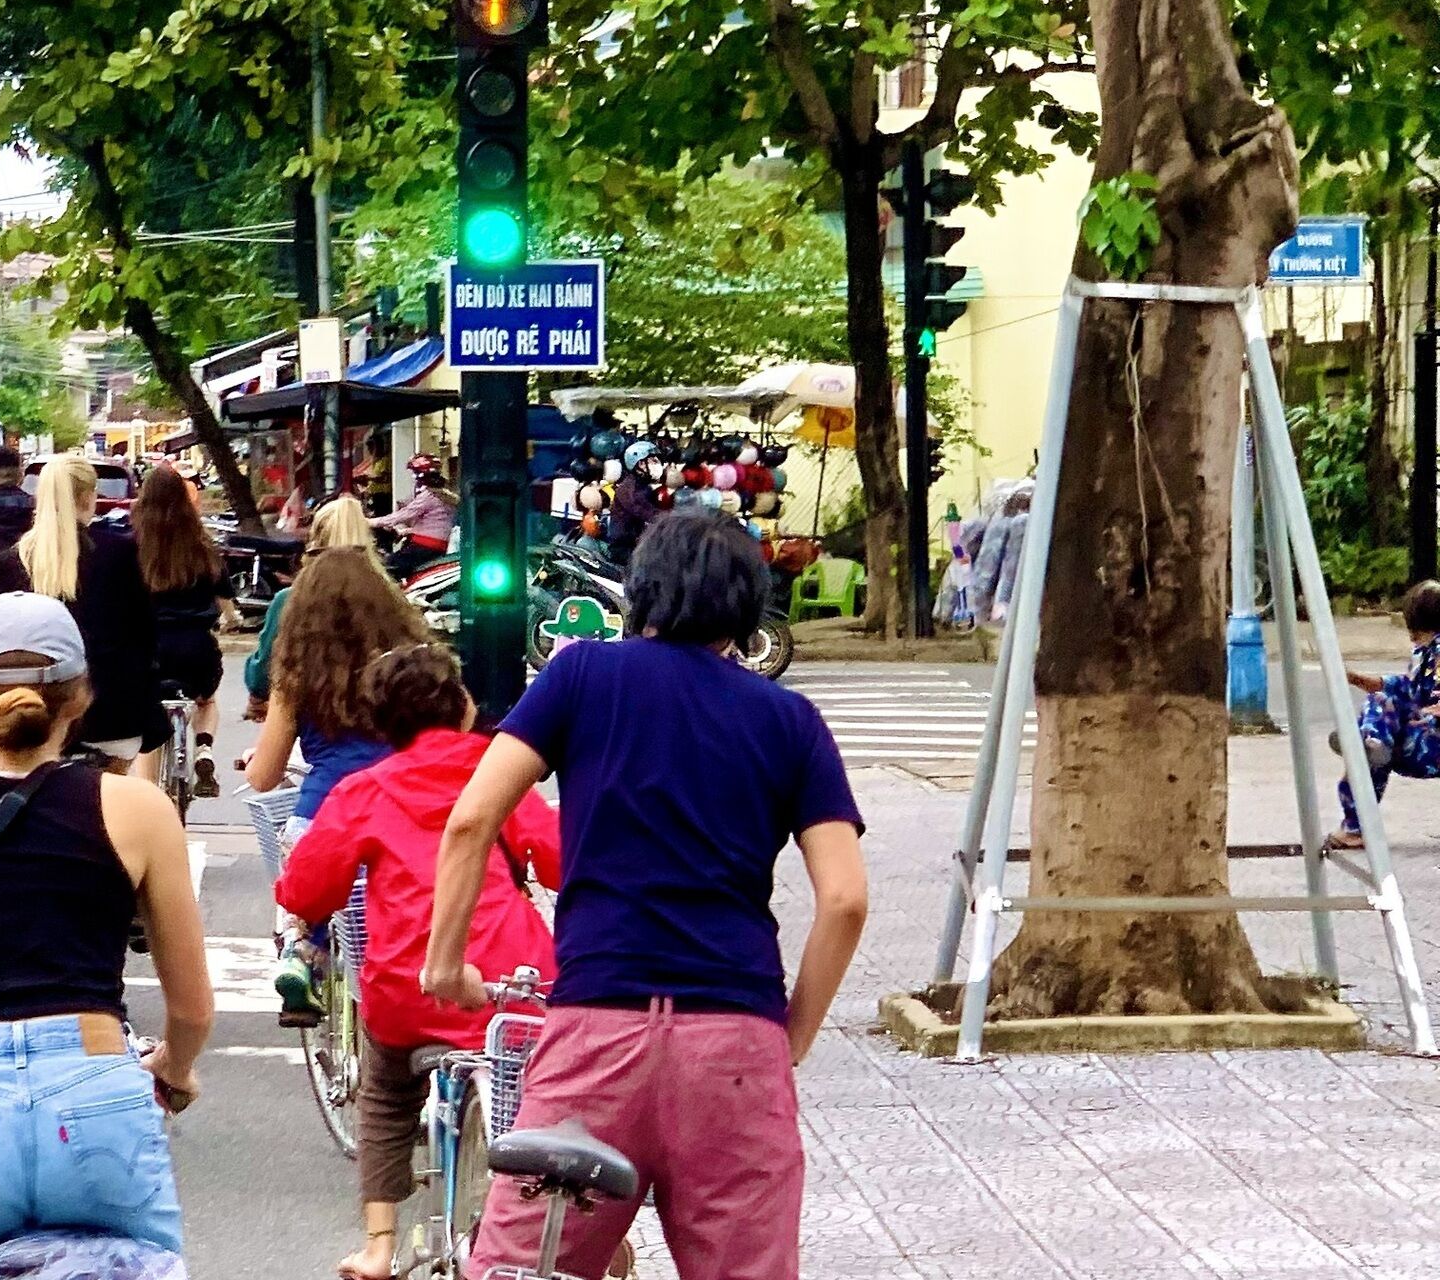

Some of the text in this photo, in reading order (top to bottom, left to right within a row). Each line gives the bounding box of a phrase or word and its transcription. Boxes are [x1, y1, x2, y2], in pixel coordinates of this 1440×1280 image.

[508, 284, 526, 308] XE
[529, 284, 552, 308] HAI
[555, 277, 593, 308] BÁNH
[461, 319, 592, 362] ĐƯỢC RẼ PHẢI
